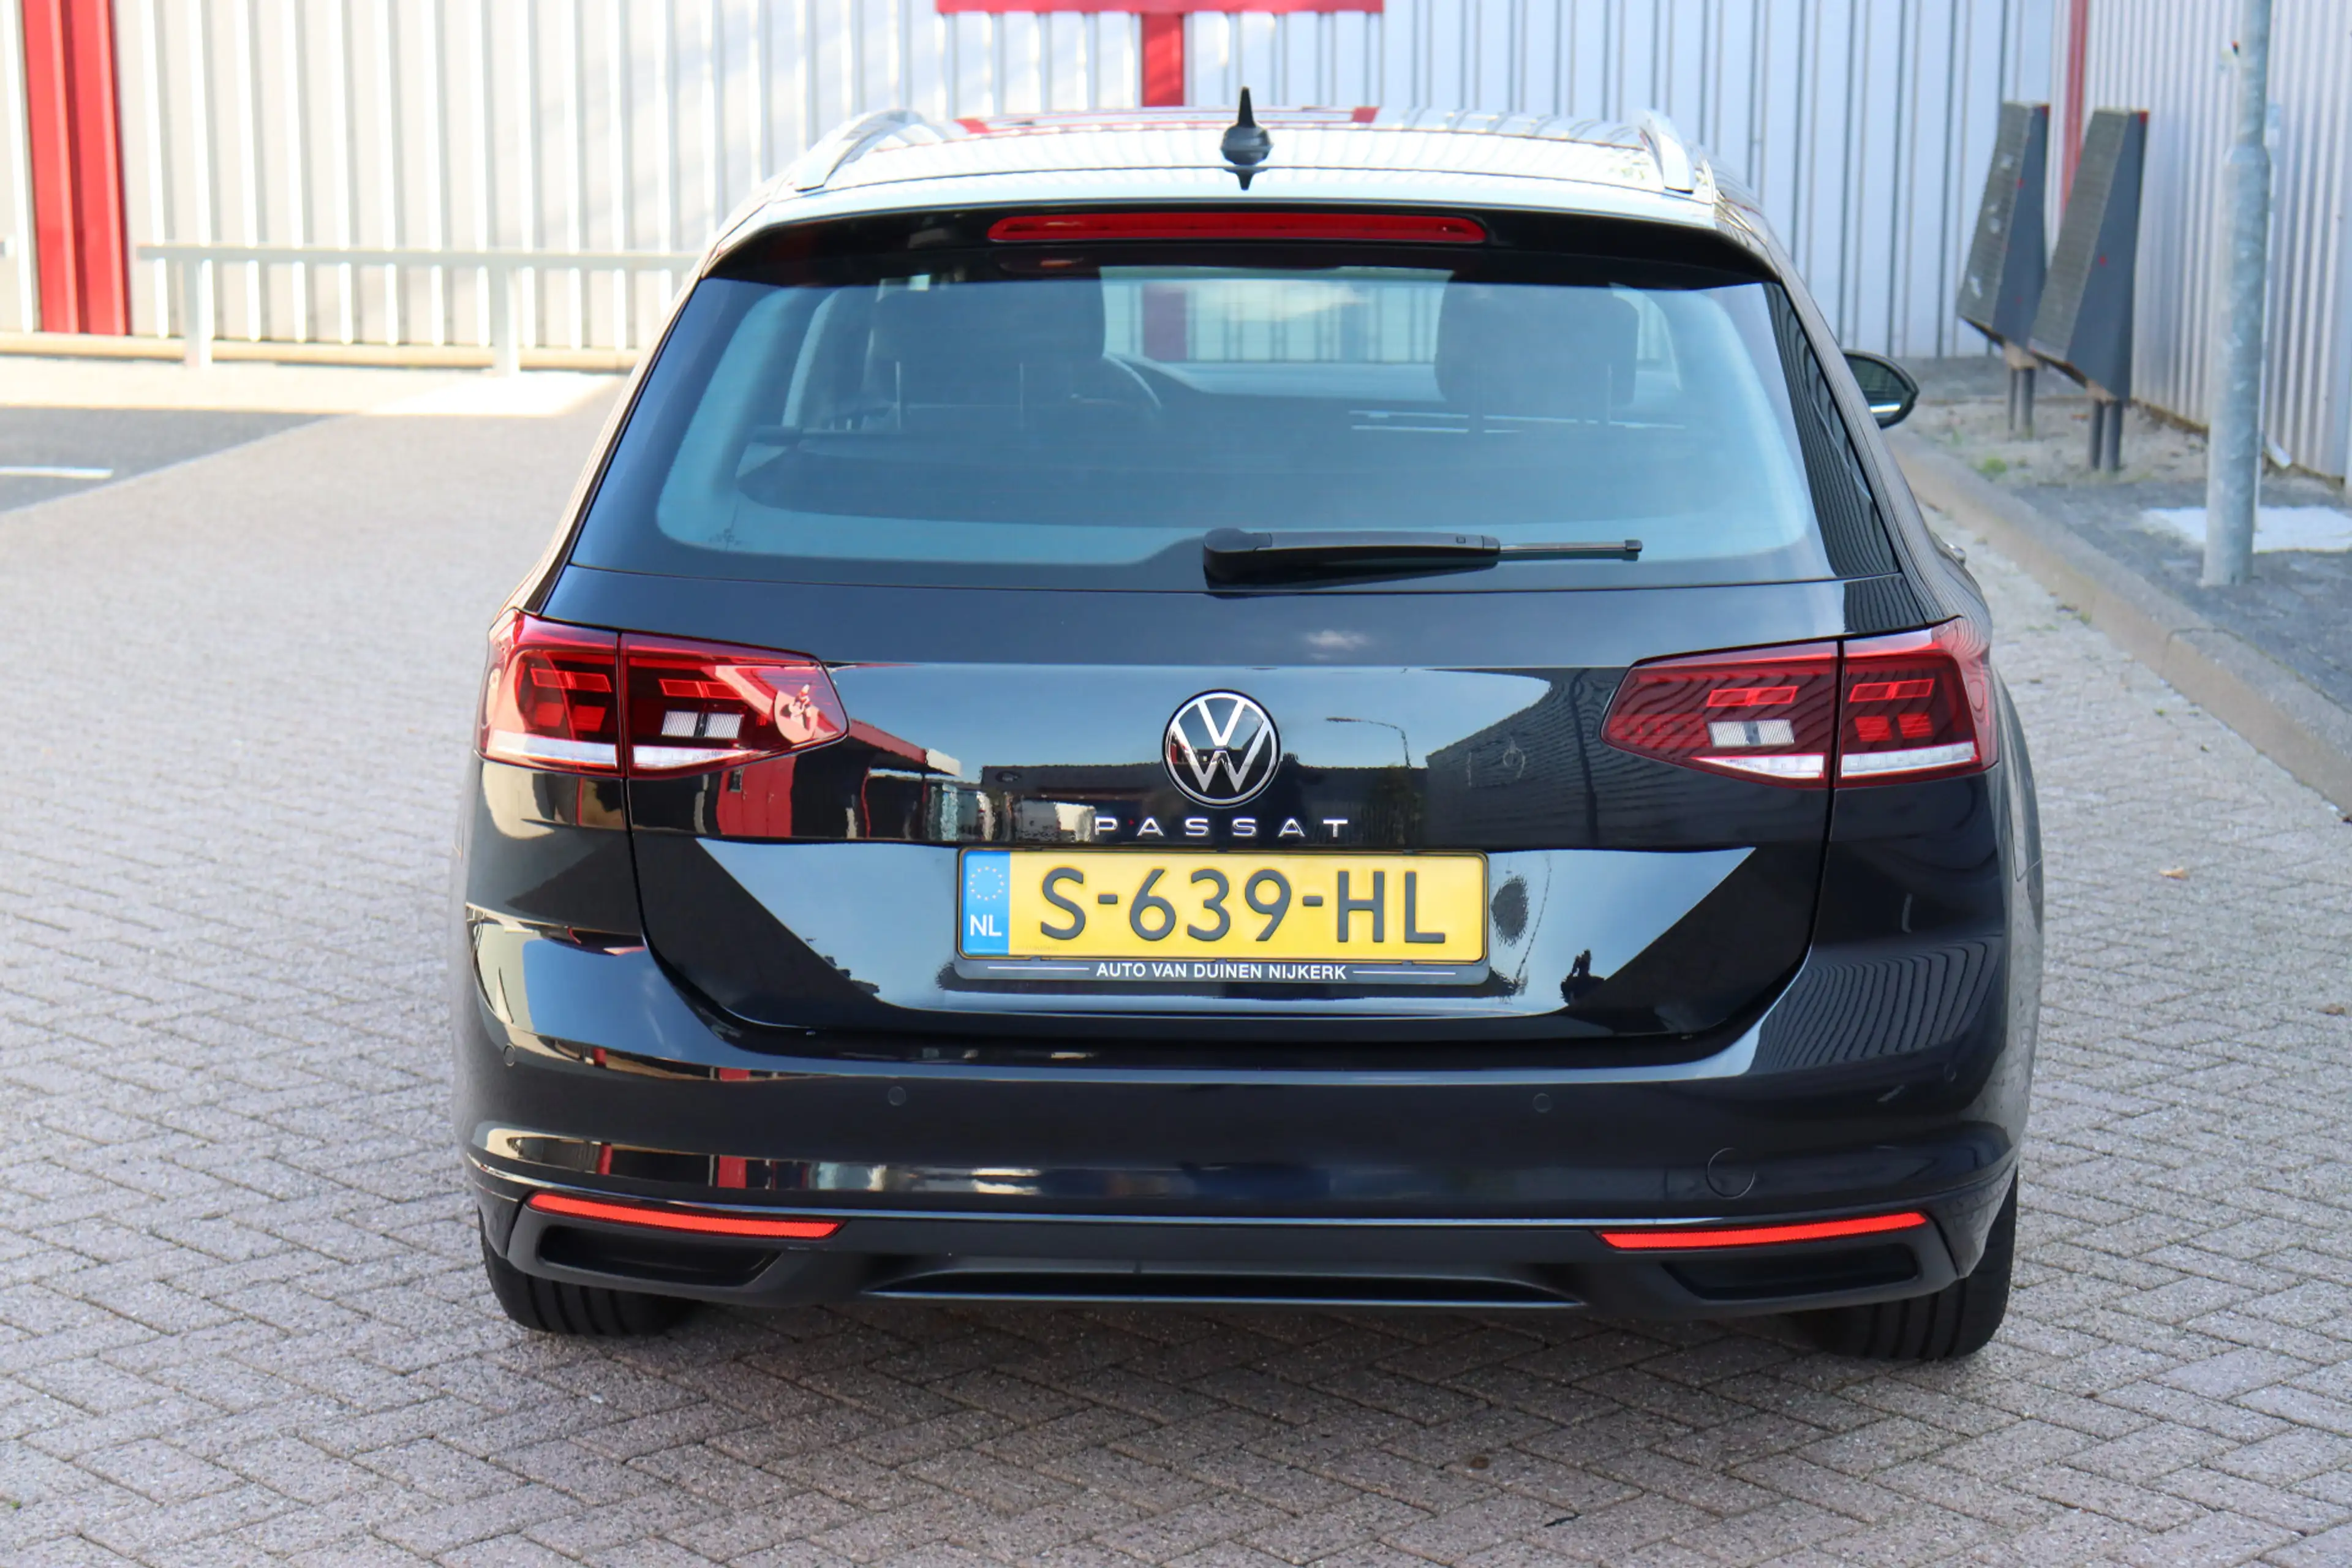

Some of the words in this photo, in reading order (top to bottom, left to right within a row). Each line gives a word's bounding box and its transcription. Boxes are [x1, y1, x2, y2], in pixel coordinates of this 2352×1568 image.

[1094, 816, 1349, 837] PASSAT
[1040, 867, 1446, 944] S-639-HL
[970, 914, 1002, 937] NL
[1096, 962, 1147, 978] AUTO
[1151, 962, 1187, 978] VAN
[1193, 963, 1262, 979] DUINEN
[1268, 964, 1347, 980] NIJKERK
